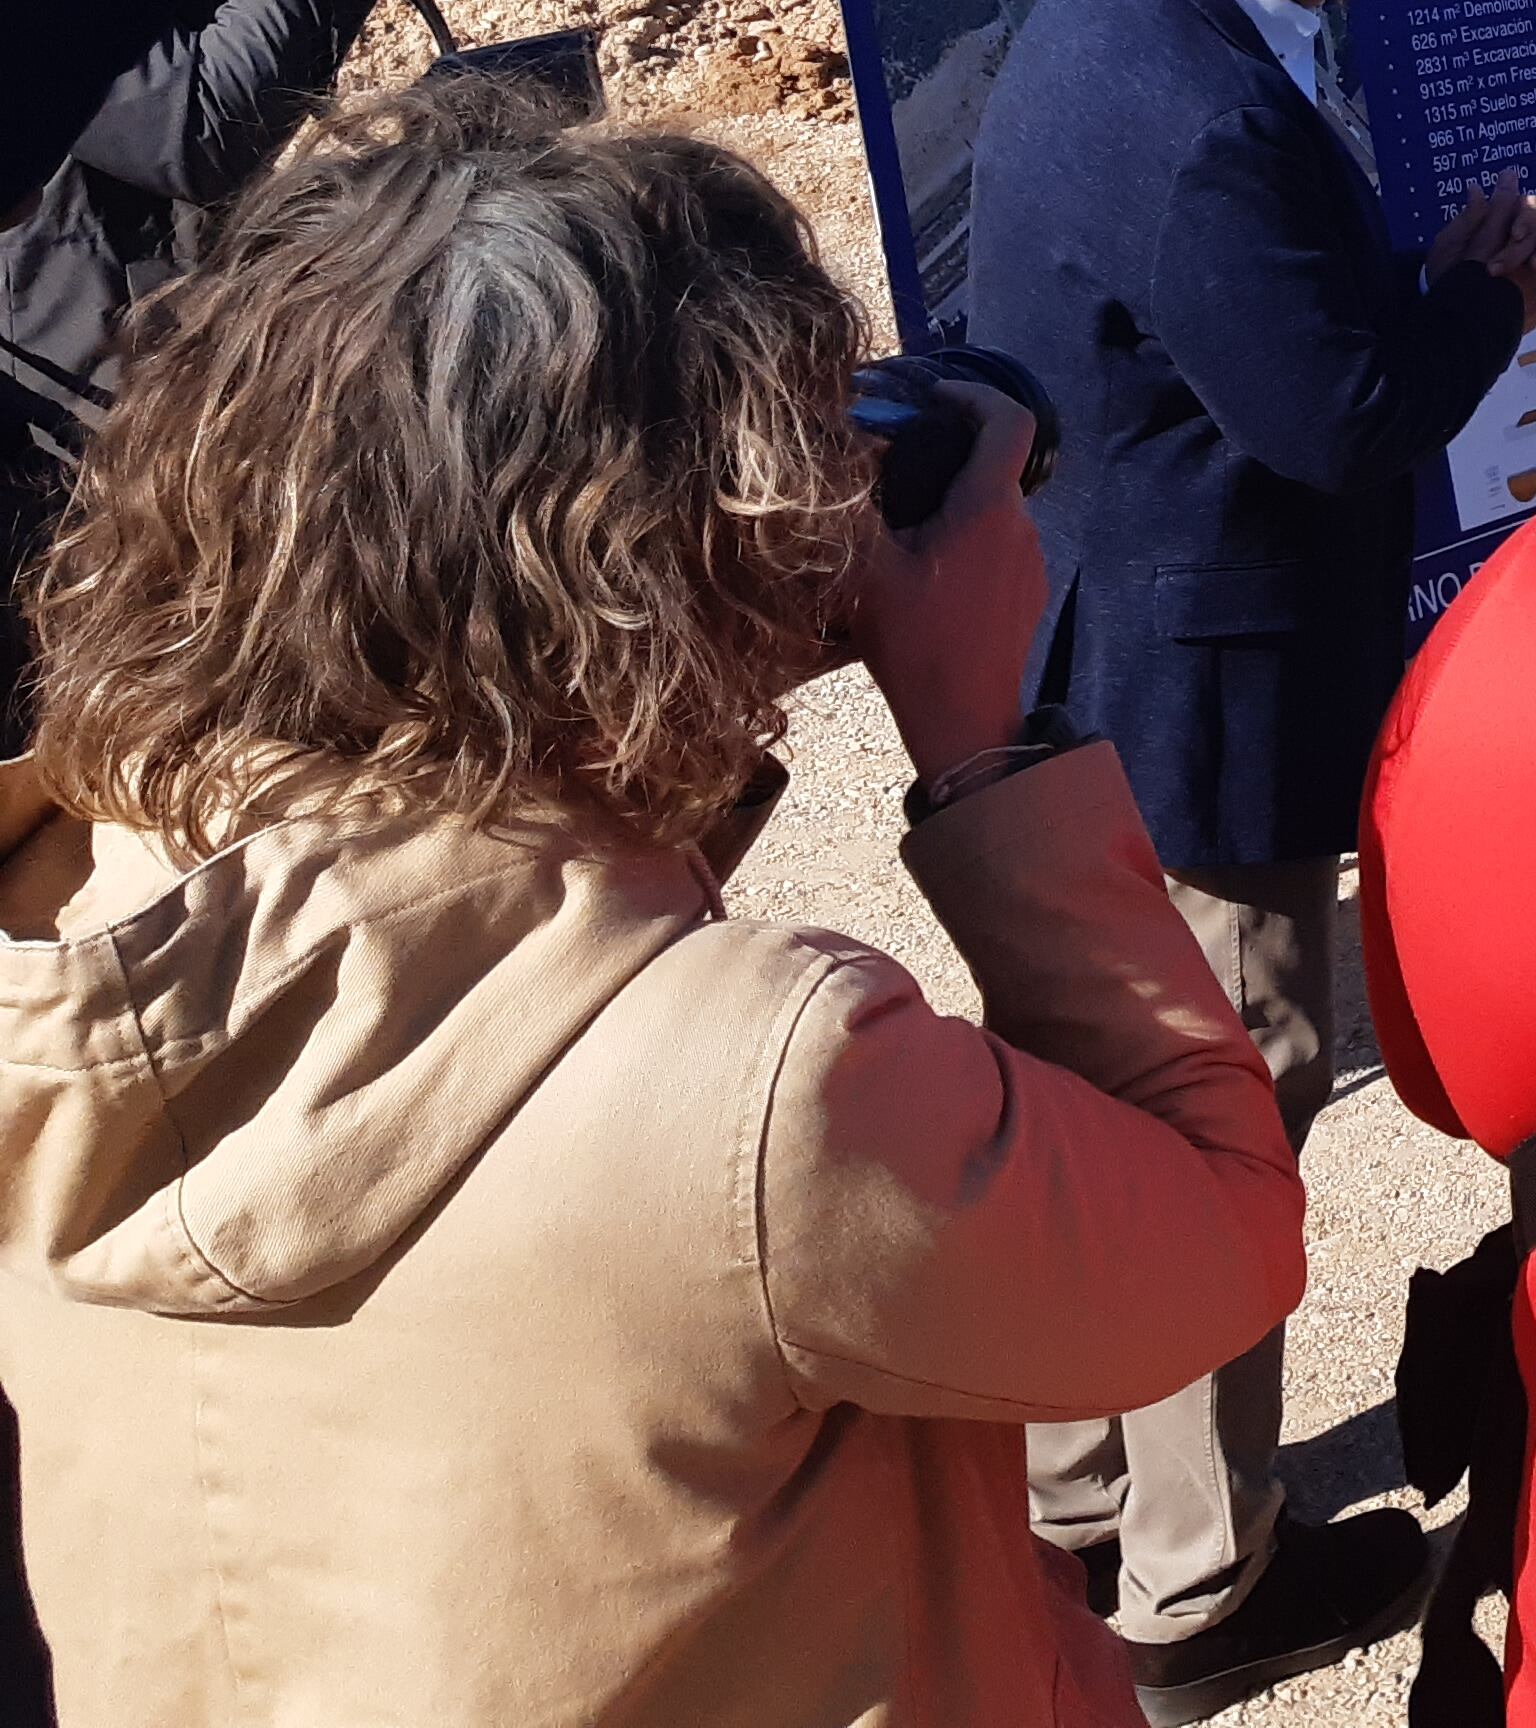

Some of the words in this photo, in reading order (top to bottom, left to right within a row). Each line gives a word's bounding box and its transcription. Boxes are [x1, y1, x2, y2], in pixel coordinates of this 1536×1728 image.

[1407, 7, 1440, 25] 1214
[1412, 32, 1437, 51] 626
[1460, 17, 1533, 42] Excavación
[1416, 55, 1448, 75] 2831
[1420, 78, 1454, 100] 9135
[1477, 77, 1485, 89] x
[1488, 72, 1507, 87] cm
[1424, 103, 1457, 123] 1315
[1480, 93, 1517, 113] Suelo
[1428, 129, 1454, 148] 966
[1456, 125, 1475, 142] Tn
[1433, 152, 1457, 172] 597
[1481, 141, 1532, 162] Zahorra
[1437, 177, 1462, 197] 240
[1440, 203, 1459, 221] 76
